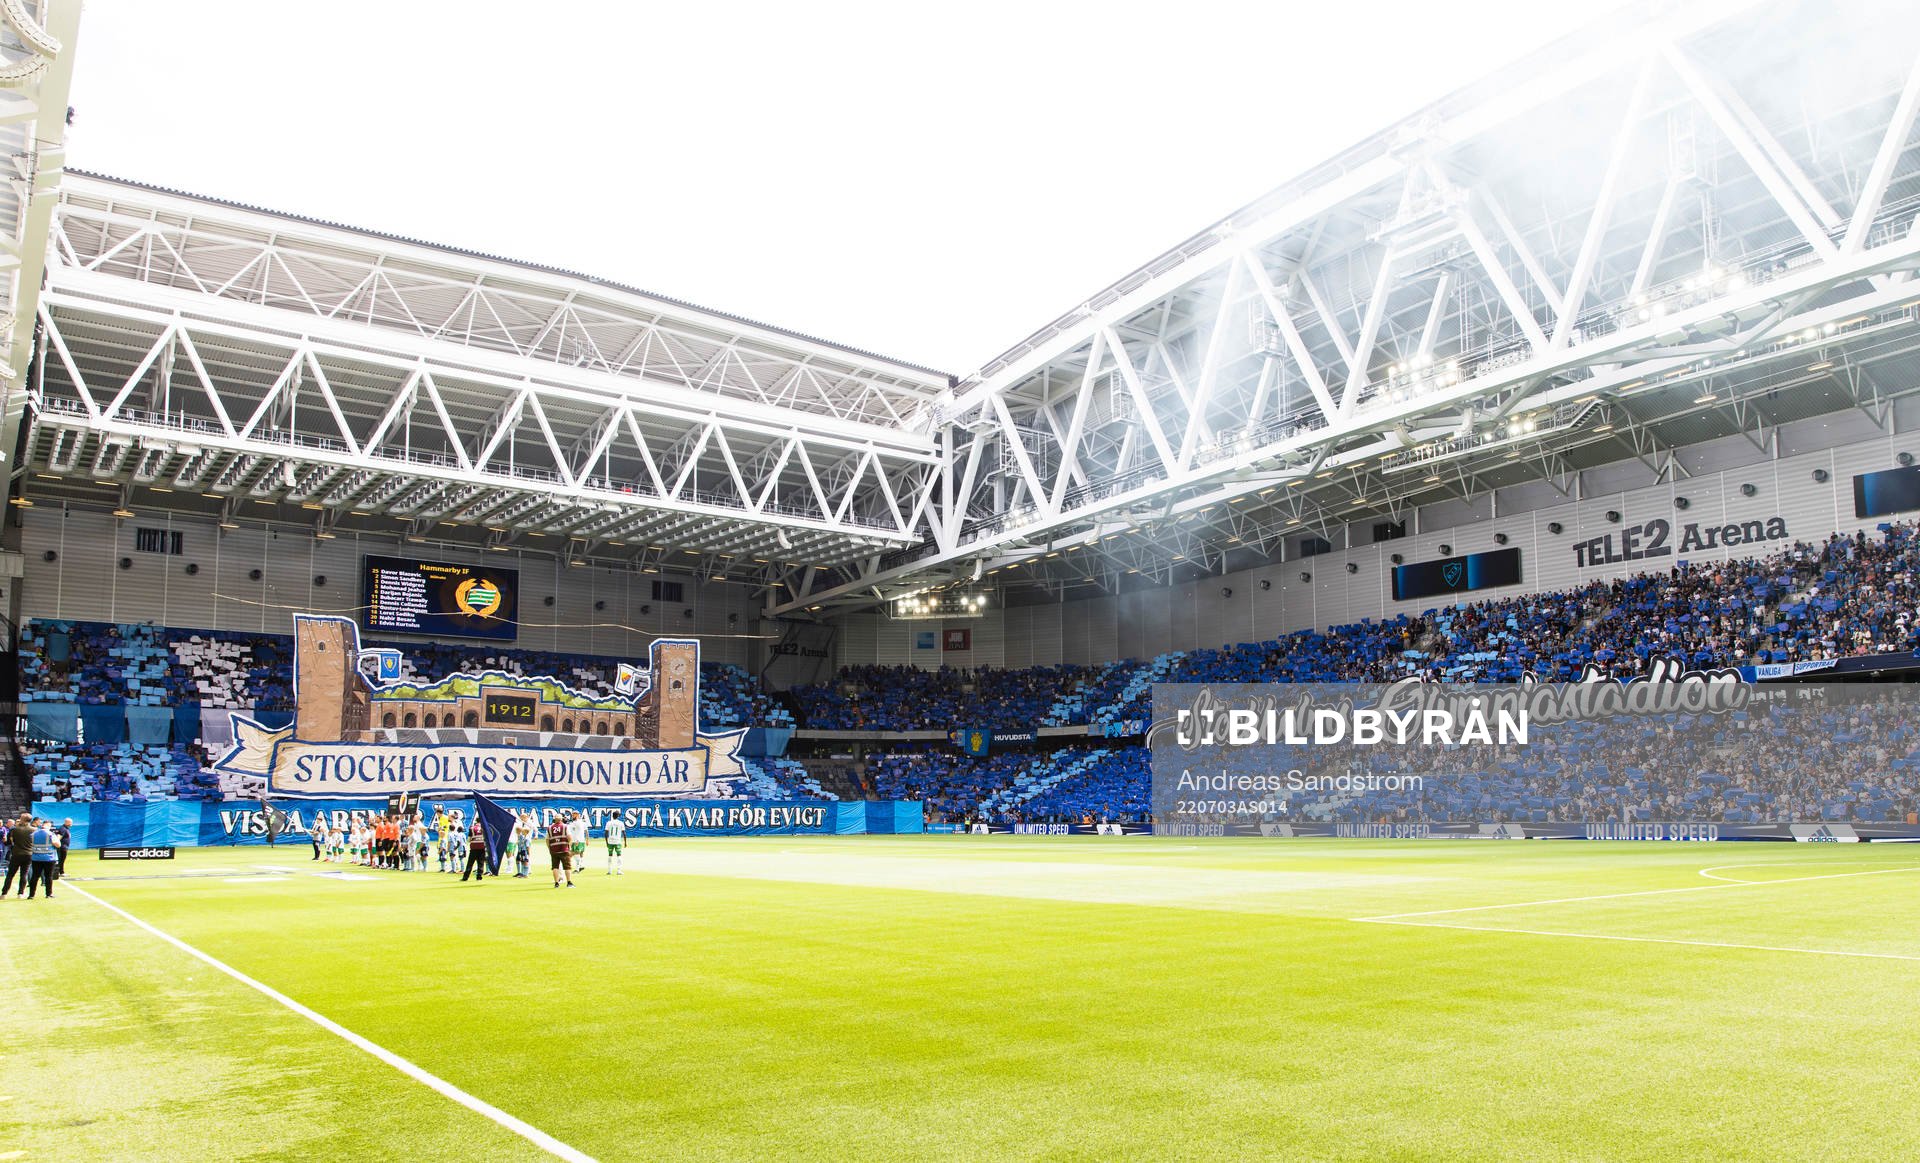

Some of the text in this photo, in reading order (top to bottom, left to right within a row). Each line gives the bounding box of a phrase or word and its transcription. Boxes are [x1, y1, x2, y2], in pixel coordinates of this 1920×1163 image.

[1572, 517, 1788, 567] TELE2 Arena
[420, 564, 461, 575] Hammarby
[1758, 666, 1782, 676] VANLIGA
[489, 703, 531, 717] 1912
[294, 754, 689, 785] STOCKHOLMS STADION 110 ÅR
[624, 803, 664, 828] STÅ
[668, 807, 725, 828] KVAR
[728, 804, 766, 827] FÖR
[769, 806, 827, 827] EVIGT
[610, 826, 619, 836] 11
[1014, 824, 1069, 835] UNLIMITED SPEED
[1155, 824, 1224, 836] UNLIMITED SPEED
[1336, 823, 1430, 839] UNLIMITED SPEED
[1585, 823, 1718, 841] UNLIMITED SPEED
[130, 848, 170, 858] adidas
